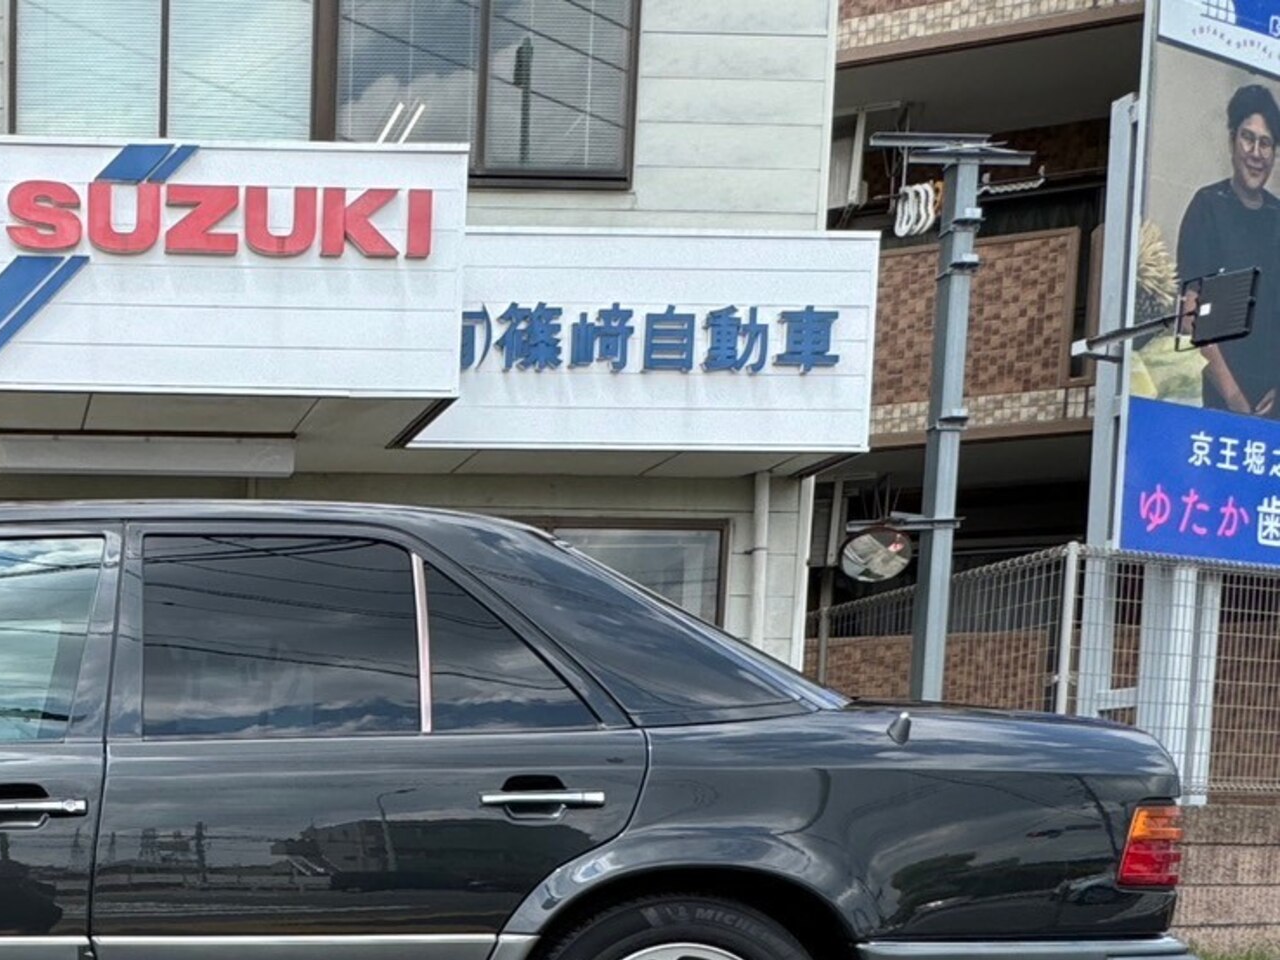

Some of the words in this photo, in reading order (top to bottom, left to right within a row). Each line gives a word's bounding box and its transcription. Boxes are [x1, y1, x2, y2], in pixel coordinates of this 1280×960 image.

[6, 179, 433, 258] SUZUKI
[1139, 483, 1280, 547] ゆたか歯
